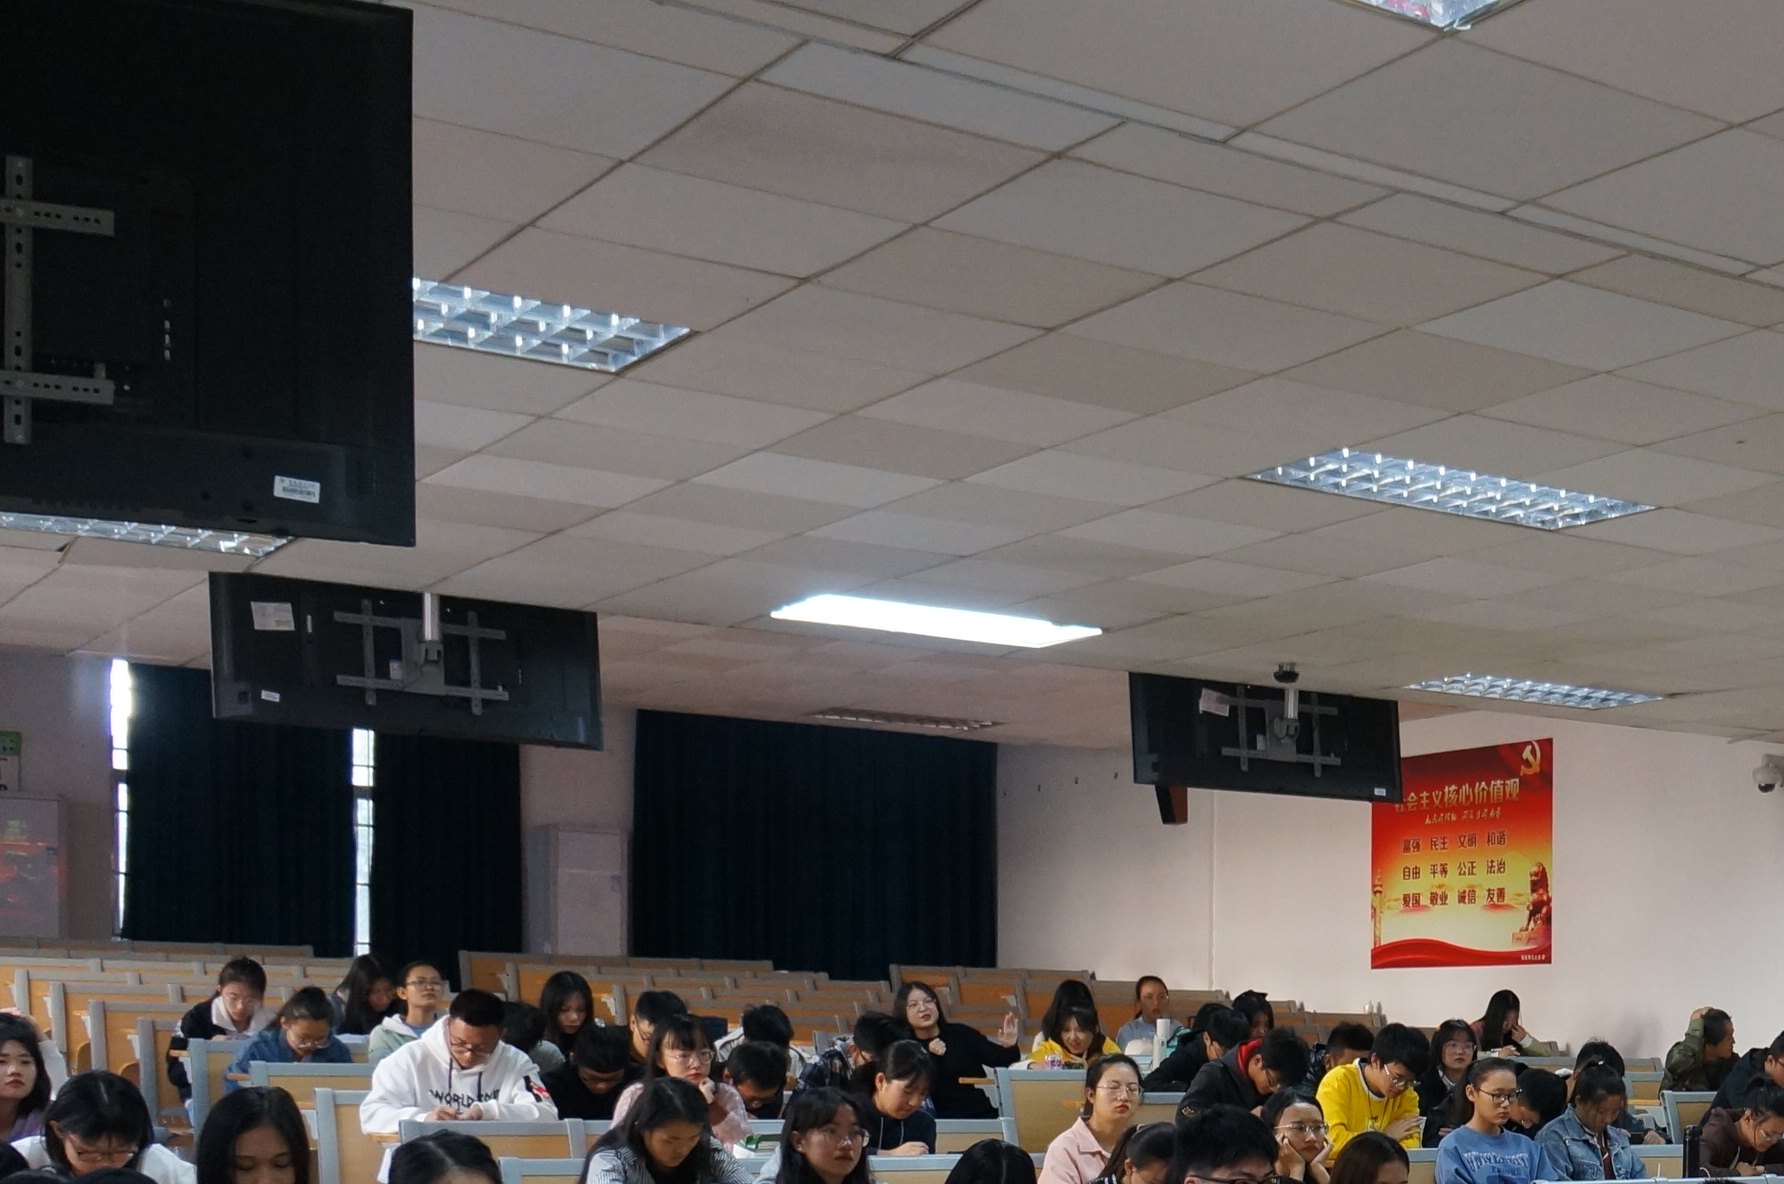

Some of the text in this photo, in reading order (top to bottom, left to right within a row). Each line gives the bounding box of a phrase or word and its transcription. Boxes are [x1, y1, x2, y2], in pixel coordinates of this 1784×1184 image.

[1402, 830, 1506, 853] 富强 民主 文明 和谐
[1402, 858, 1506, 880] 自由 平等 公正 法治
[1402, 887, 1506, 908] 爱国 敬业 诚信 友善
